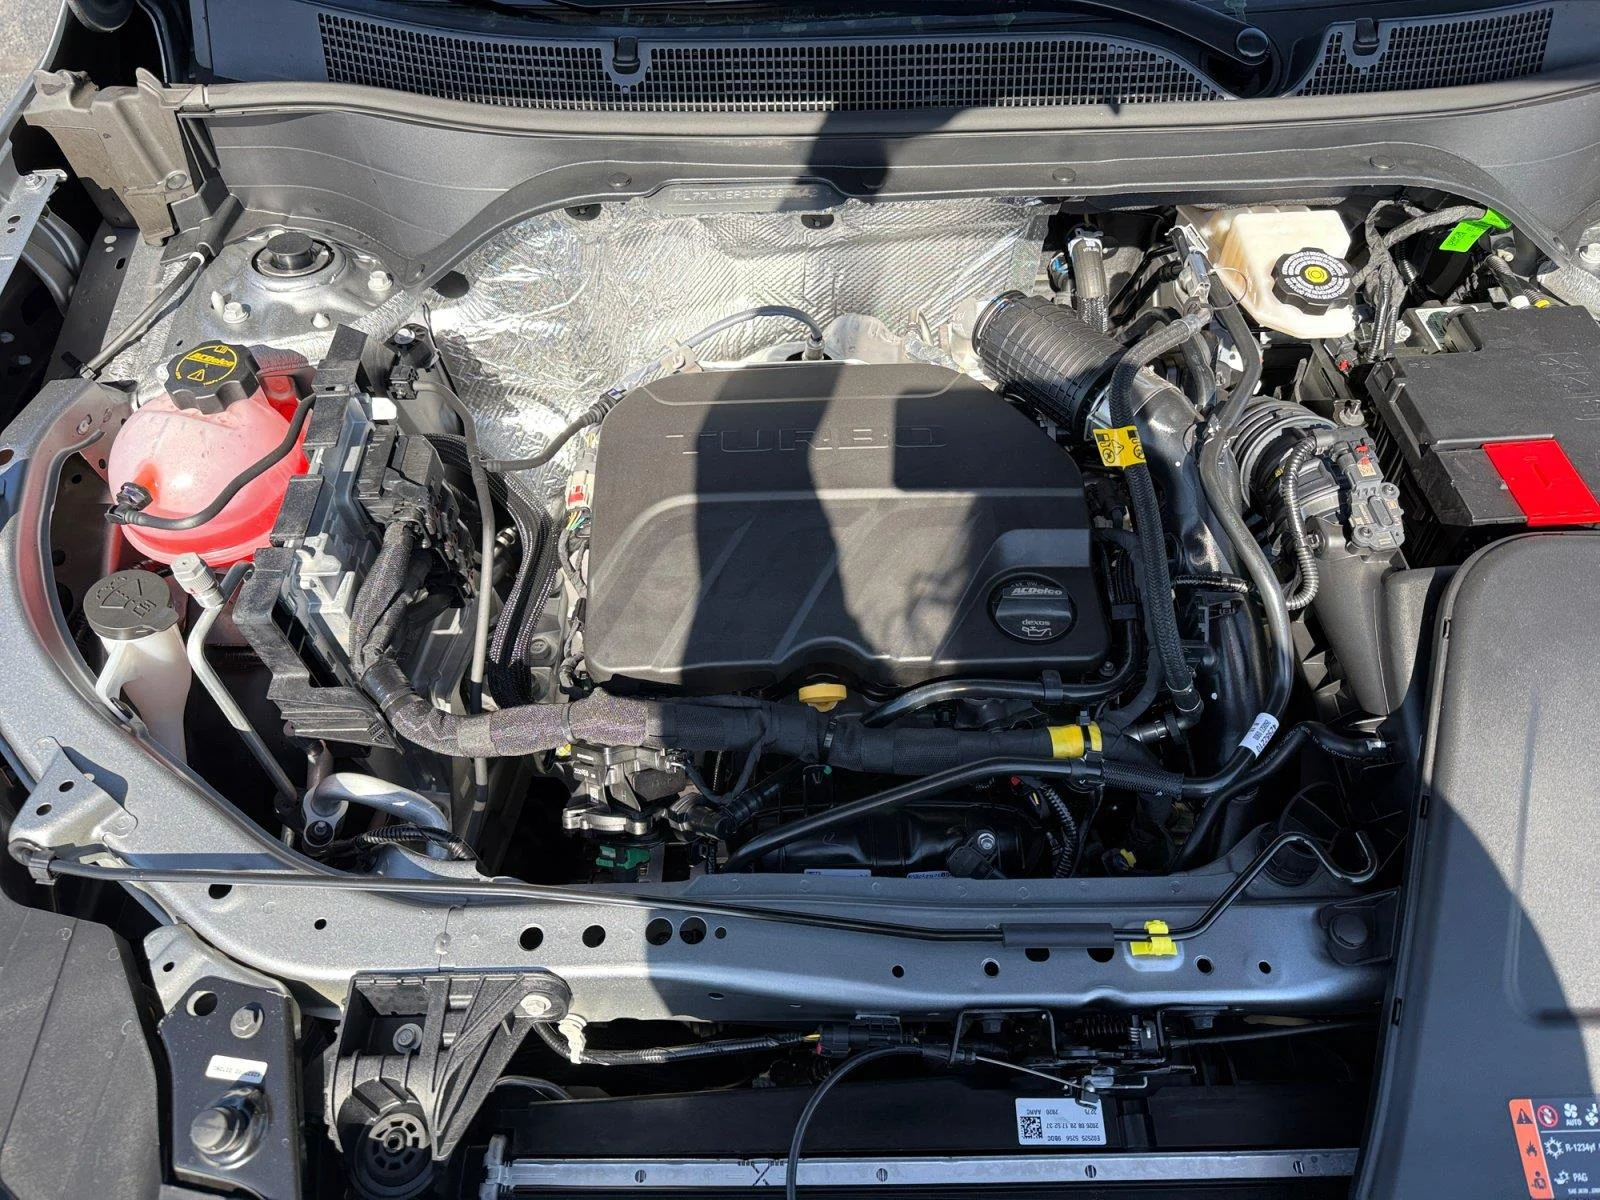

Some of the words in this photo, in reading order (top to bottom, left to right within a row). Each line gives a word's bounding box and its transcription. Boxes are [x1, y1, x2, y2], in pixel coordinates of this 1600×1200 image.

[665, 426, 948, 456] TURBO
[1010, 587, 1063, 596] ACDelco
[1573, 1173, 1588, 1182] PAG
